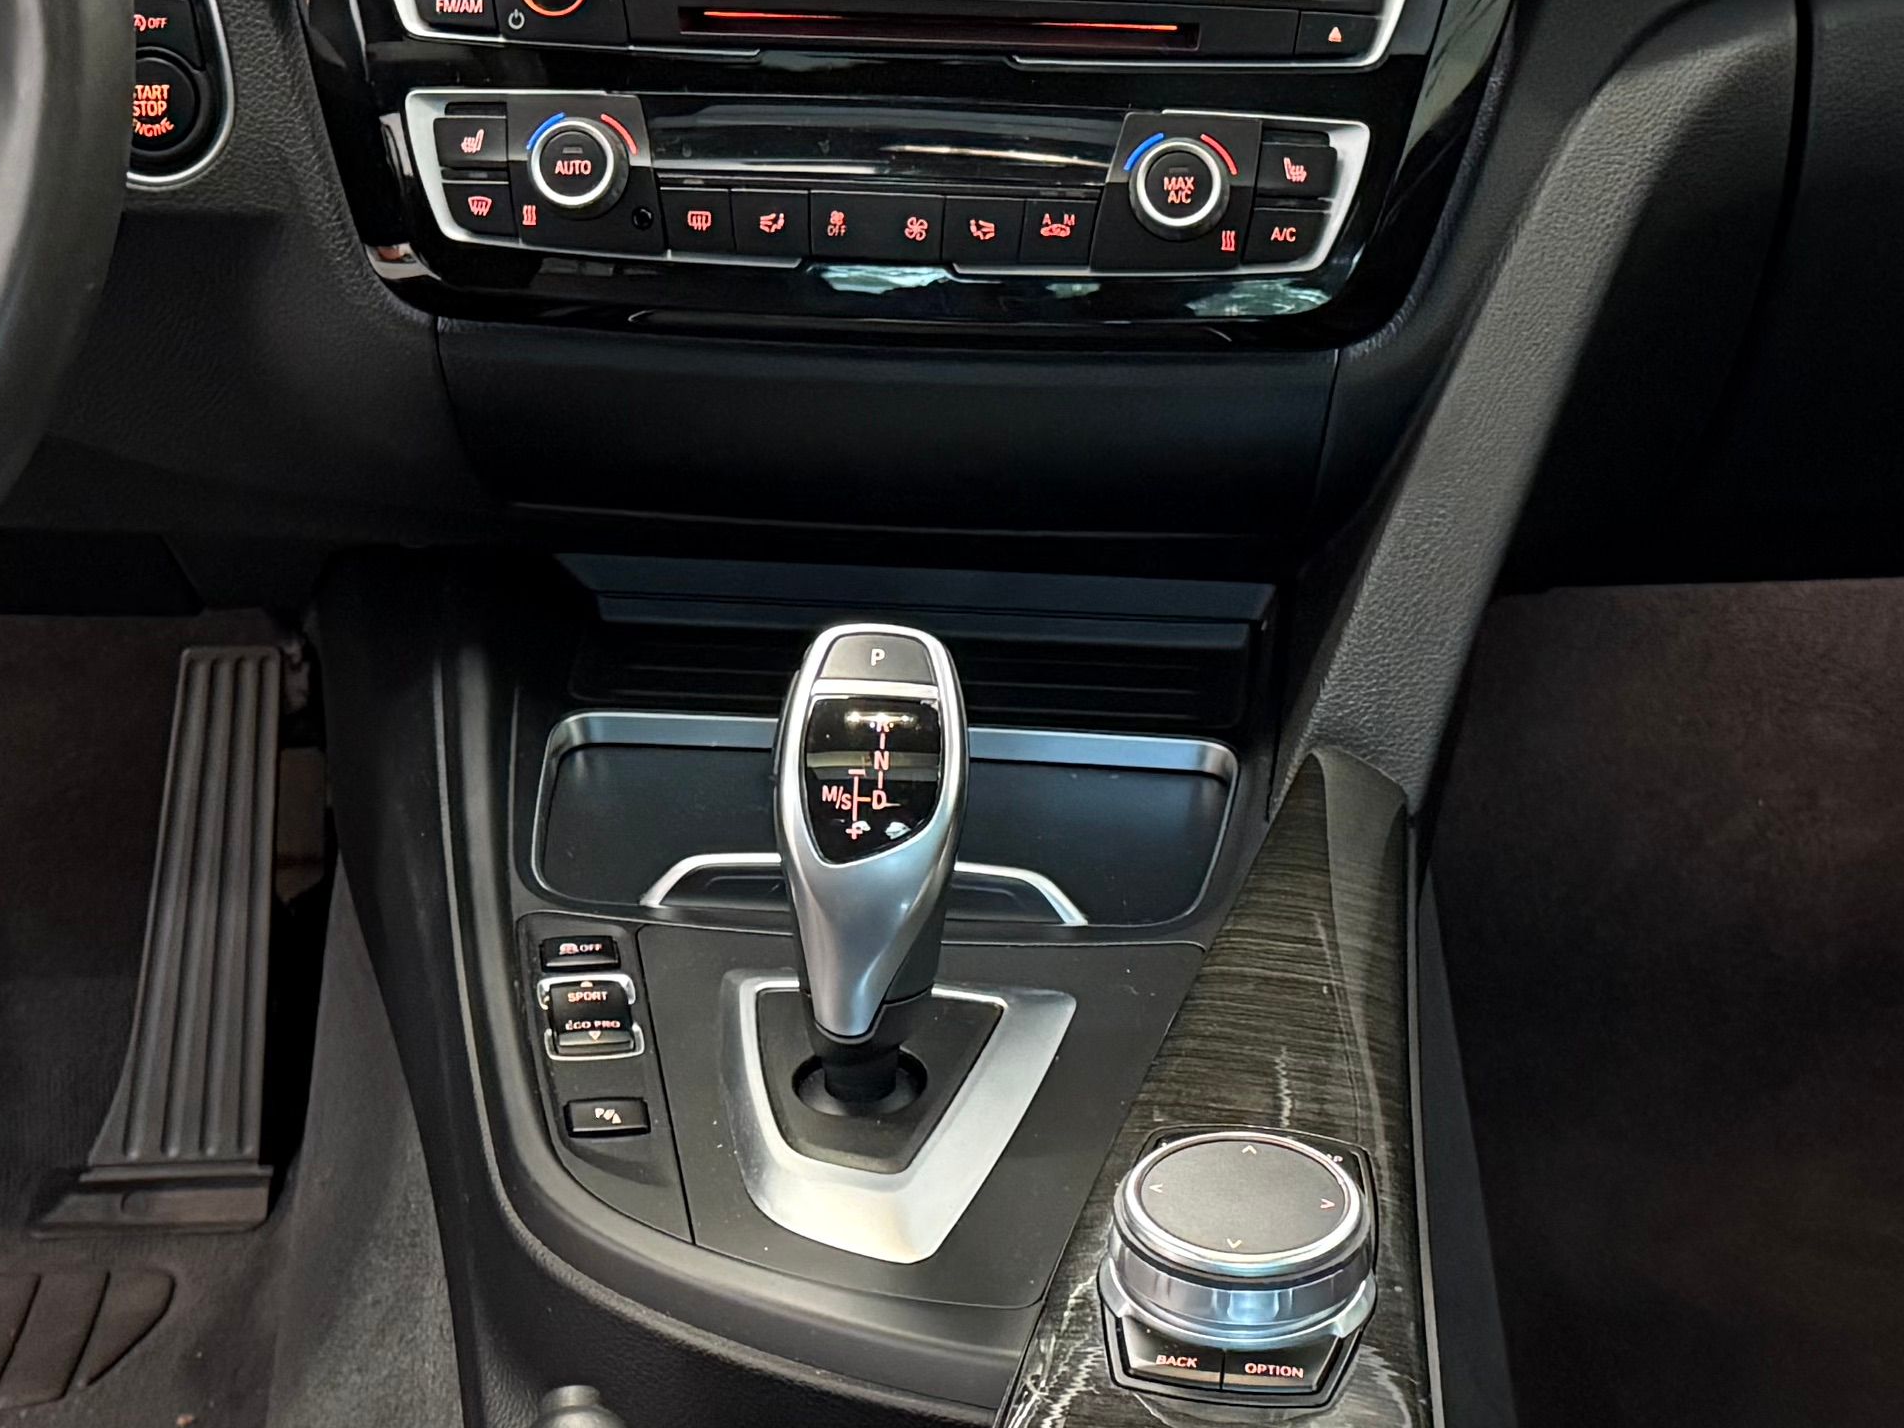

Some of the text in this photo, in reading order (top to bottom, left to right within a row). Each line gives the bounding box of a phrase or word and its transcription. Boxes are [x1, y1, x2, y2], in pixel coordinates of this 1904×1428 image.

[147, 17, 168, 29] OFF
[133, 84, 170, 100] TART
[133, 117, 175, 137] NGINE
[554, 159, 592, 176] AUTO
[1163, 176, 1195, 191] MAX
[1167, 190, 1192, 204] A/C
[827, 225, 847, 236] OFF
[1270, 227, 1297, 242] A/C
[870, 648, 886, 666] P
[874, 751, 889, 770] N
[821, 785, 852, 811] M/S
[872, 789, 887, 810] D
[579, 943, 603, 952] OFF
[567, 991, 608, 1003] SPORT
[594, 1020, 621, 1028] PRO
[1155, 1354, 1198, 1368] BACK
[1244, 1362, 1305, 1379] OPTION
